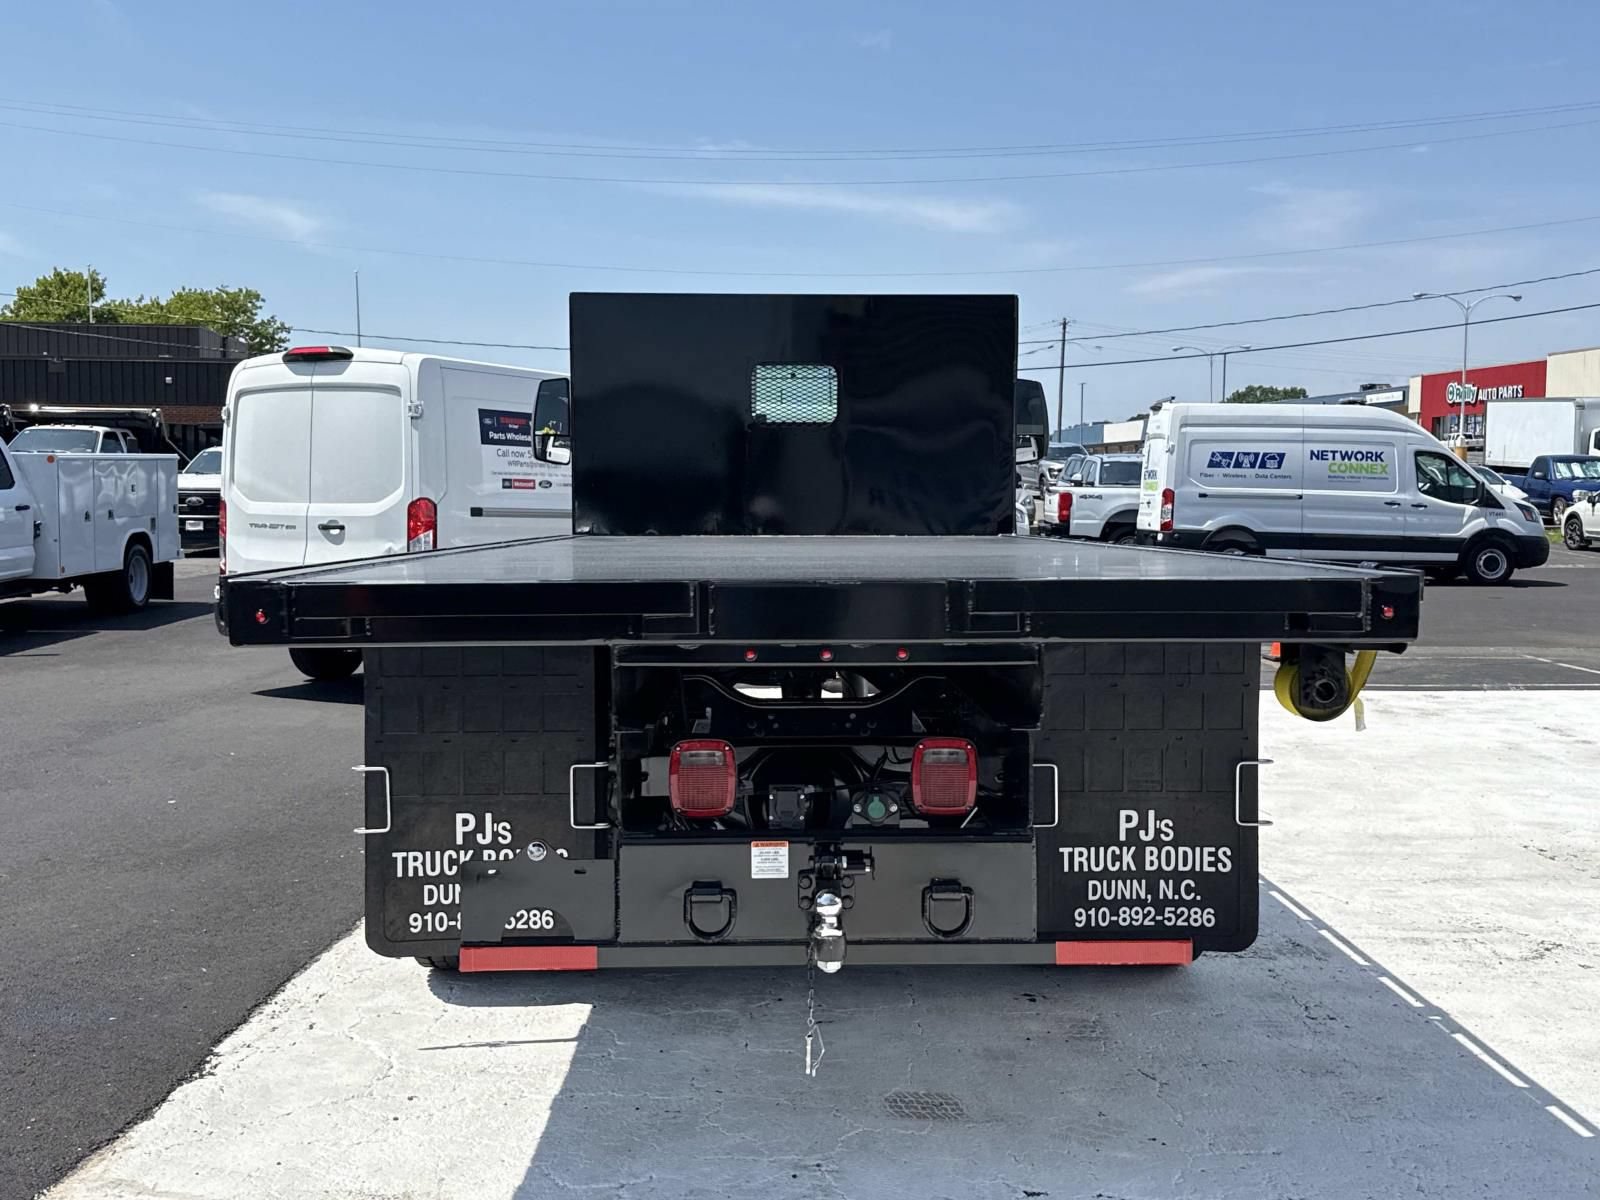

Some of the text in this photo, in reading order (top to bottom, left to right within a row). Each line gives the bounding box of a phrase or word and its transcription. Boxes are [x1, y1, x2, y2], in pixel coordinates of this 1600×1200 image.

[1478, 387, 1497, 400] AUTO
[1499, 385, 1522, 399] PARTS
[489, 431, 506, 440] Parts
[497, 448, 510, 458] Call
[1310, 450, 1384, 462] NETWORK
[1328, 462, 1389, 474] CONNEX
[1059, 845, 1232, 872] TRUCK BODIES
[1088, 879, 1202, 903] DUNN, N.C.
[1074, 907, 1216, 927] 910-892-5286
